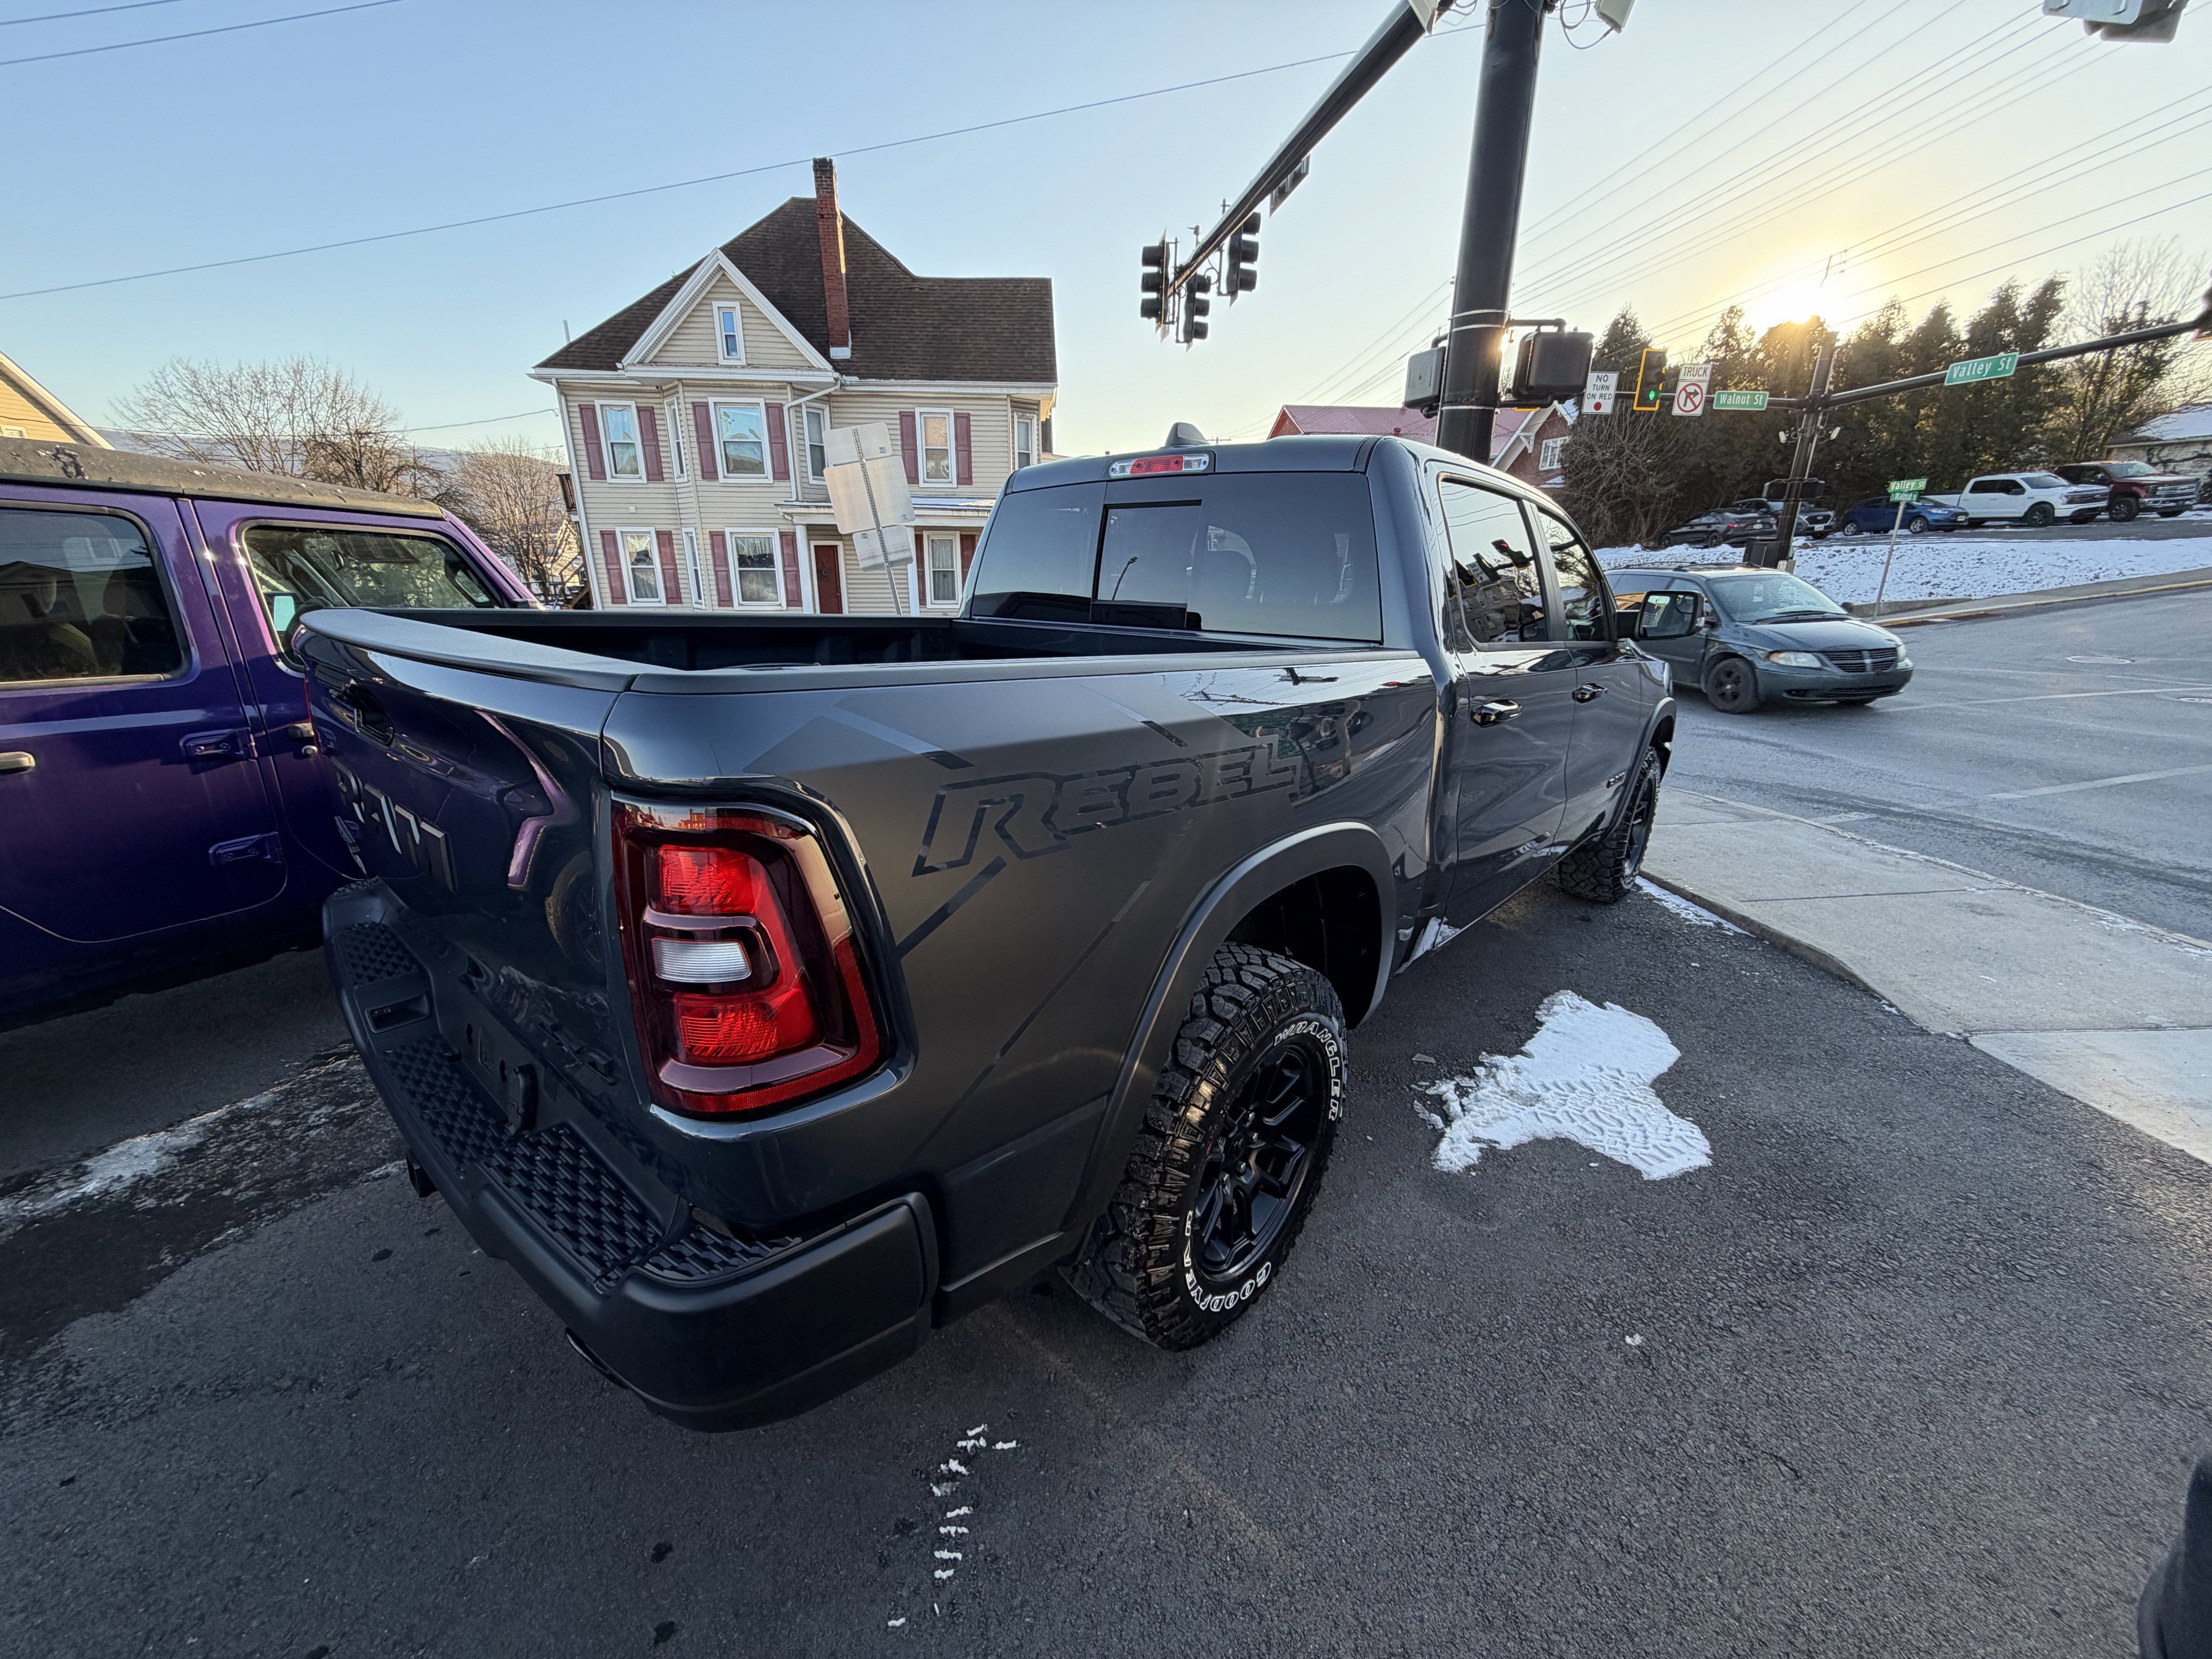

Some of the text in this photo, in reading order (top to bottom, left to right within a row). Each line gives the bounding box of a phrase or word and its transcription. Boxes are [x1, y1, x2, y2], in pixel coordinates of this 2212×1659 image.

[1683, 366, 1709, 377] TRUCK
[1953, 357, 2012, 378] Valley St
[1719, 393, 1764, 405] Walnut St
[1891, 480, 1915, 490] Valley
[912, 735, 1301, 878] REBEL
[1274, 1021, 1340, 1121] WRANGLER
[1183, 1210, 1271, 1312] GOODYEAR
